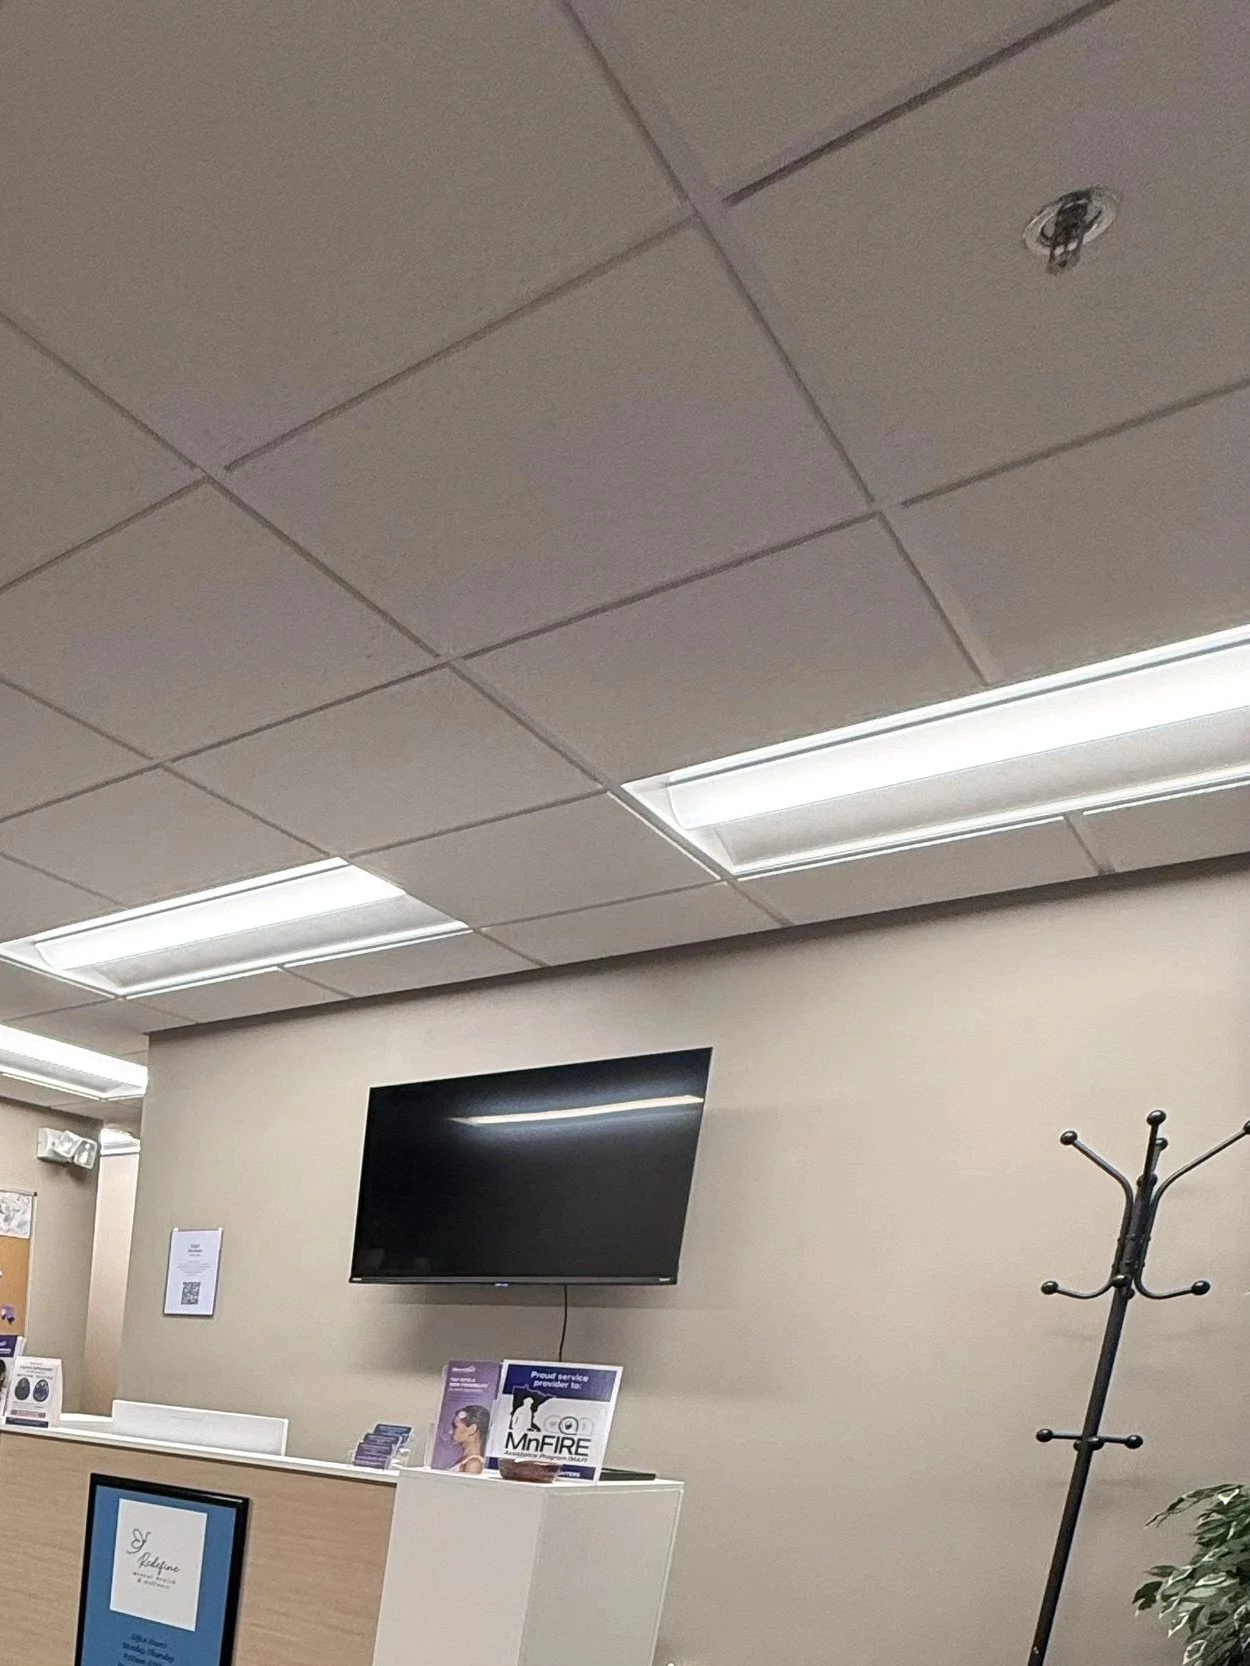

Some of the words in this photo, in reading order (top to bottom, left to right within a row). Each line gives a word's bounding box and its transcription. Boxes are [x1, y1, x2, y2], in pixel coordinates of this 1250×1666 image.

[530, 1371, 556, 1381] Proud
[557, 1372, 590, 1382] service
[534, 1380, 569, 1389] provider
[570, 1381, 582, 1390] to:
[505, 1431, 592, 1457] MnFIRE
[138, 1552, 180, 1576] Redefine
